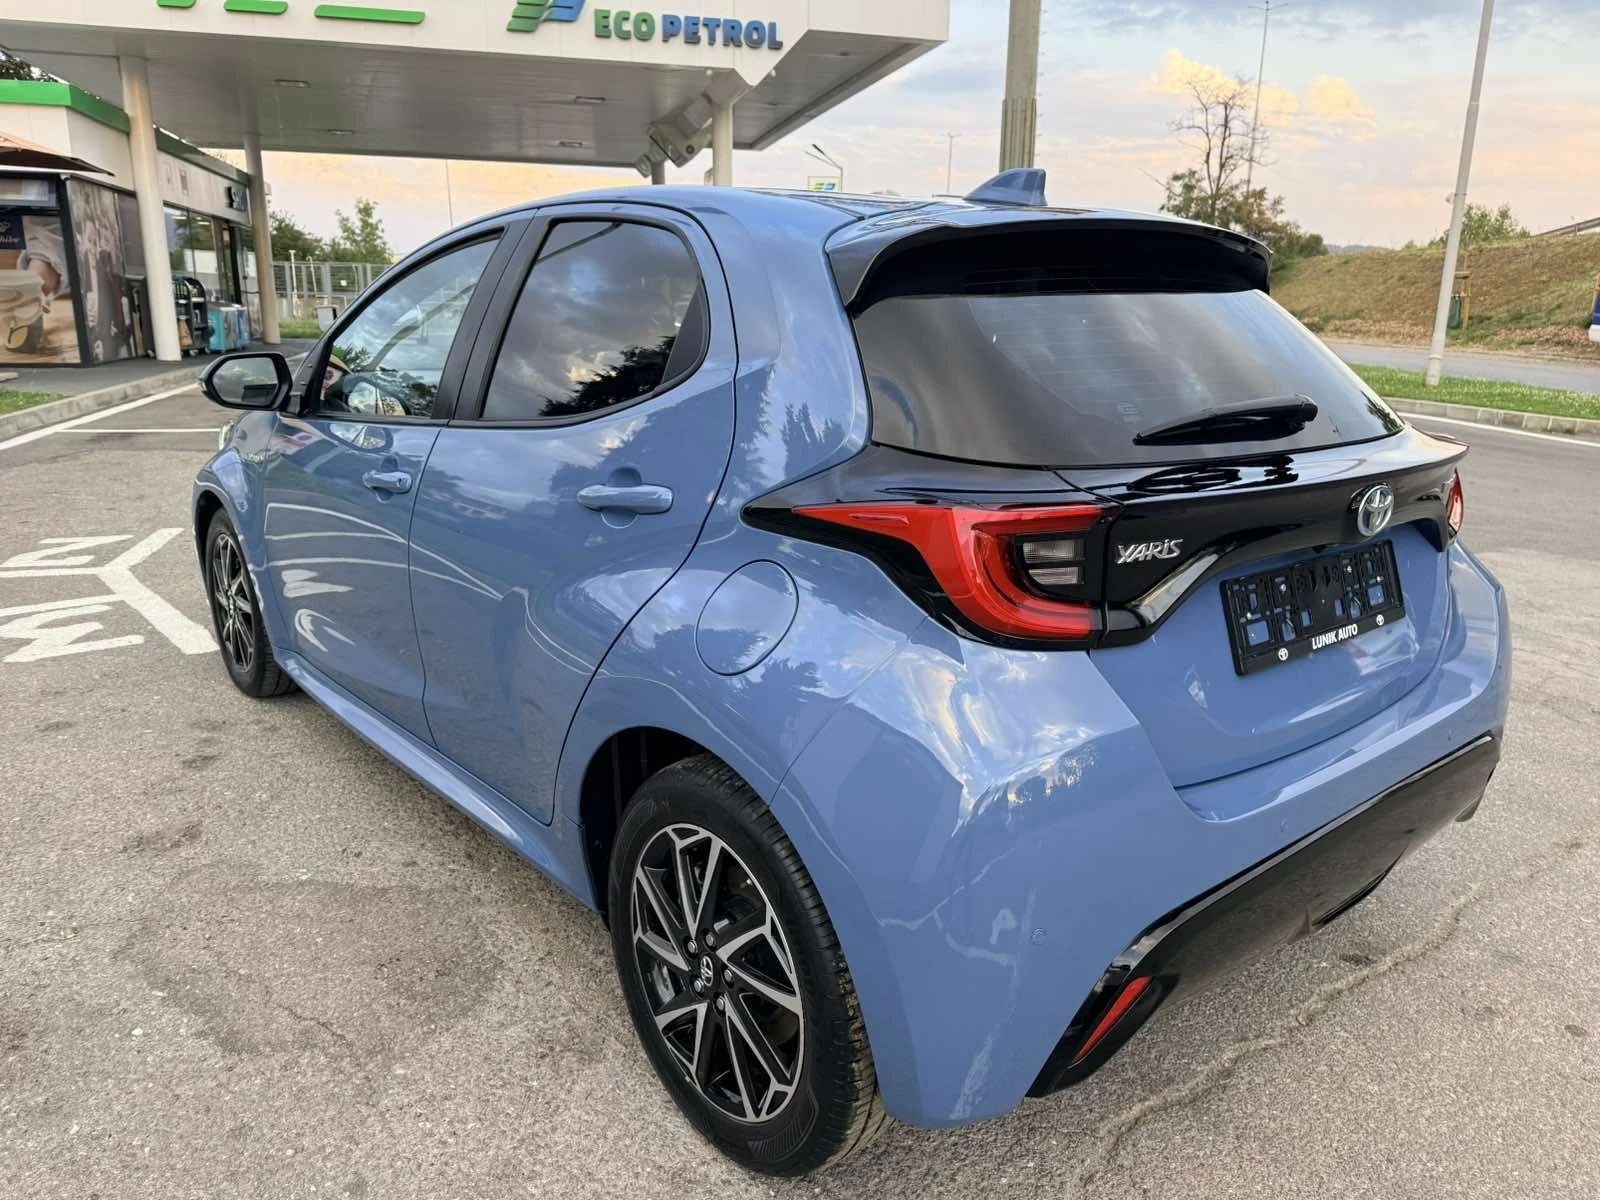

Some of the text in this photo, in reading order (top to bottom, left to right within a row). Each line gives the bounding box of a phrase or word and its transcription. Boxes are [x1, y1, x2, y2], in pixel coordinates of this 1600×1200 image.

[594, 8, 784, 50] ECO PETROL
[1311, 623, 1358, 650] LUNIK AUTO
